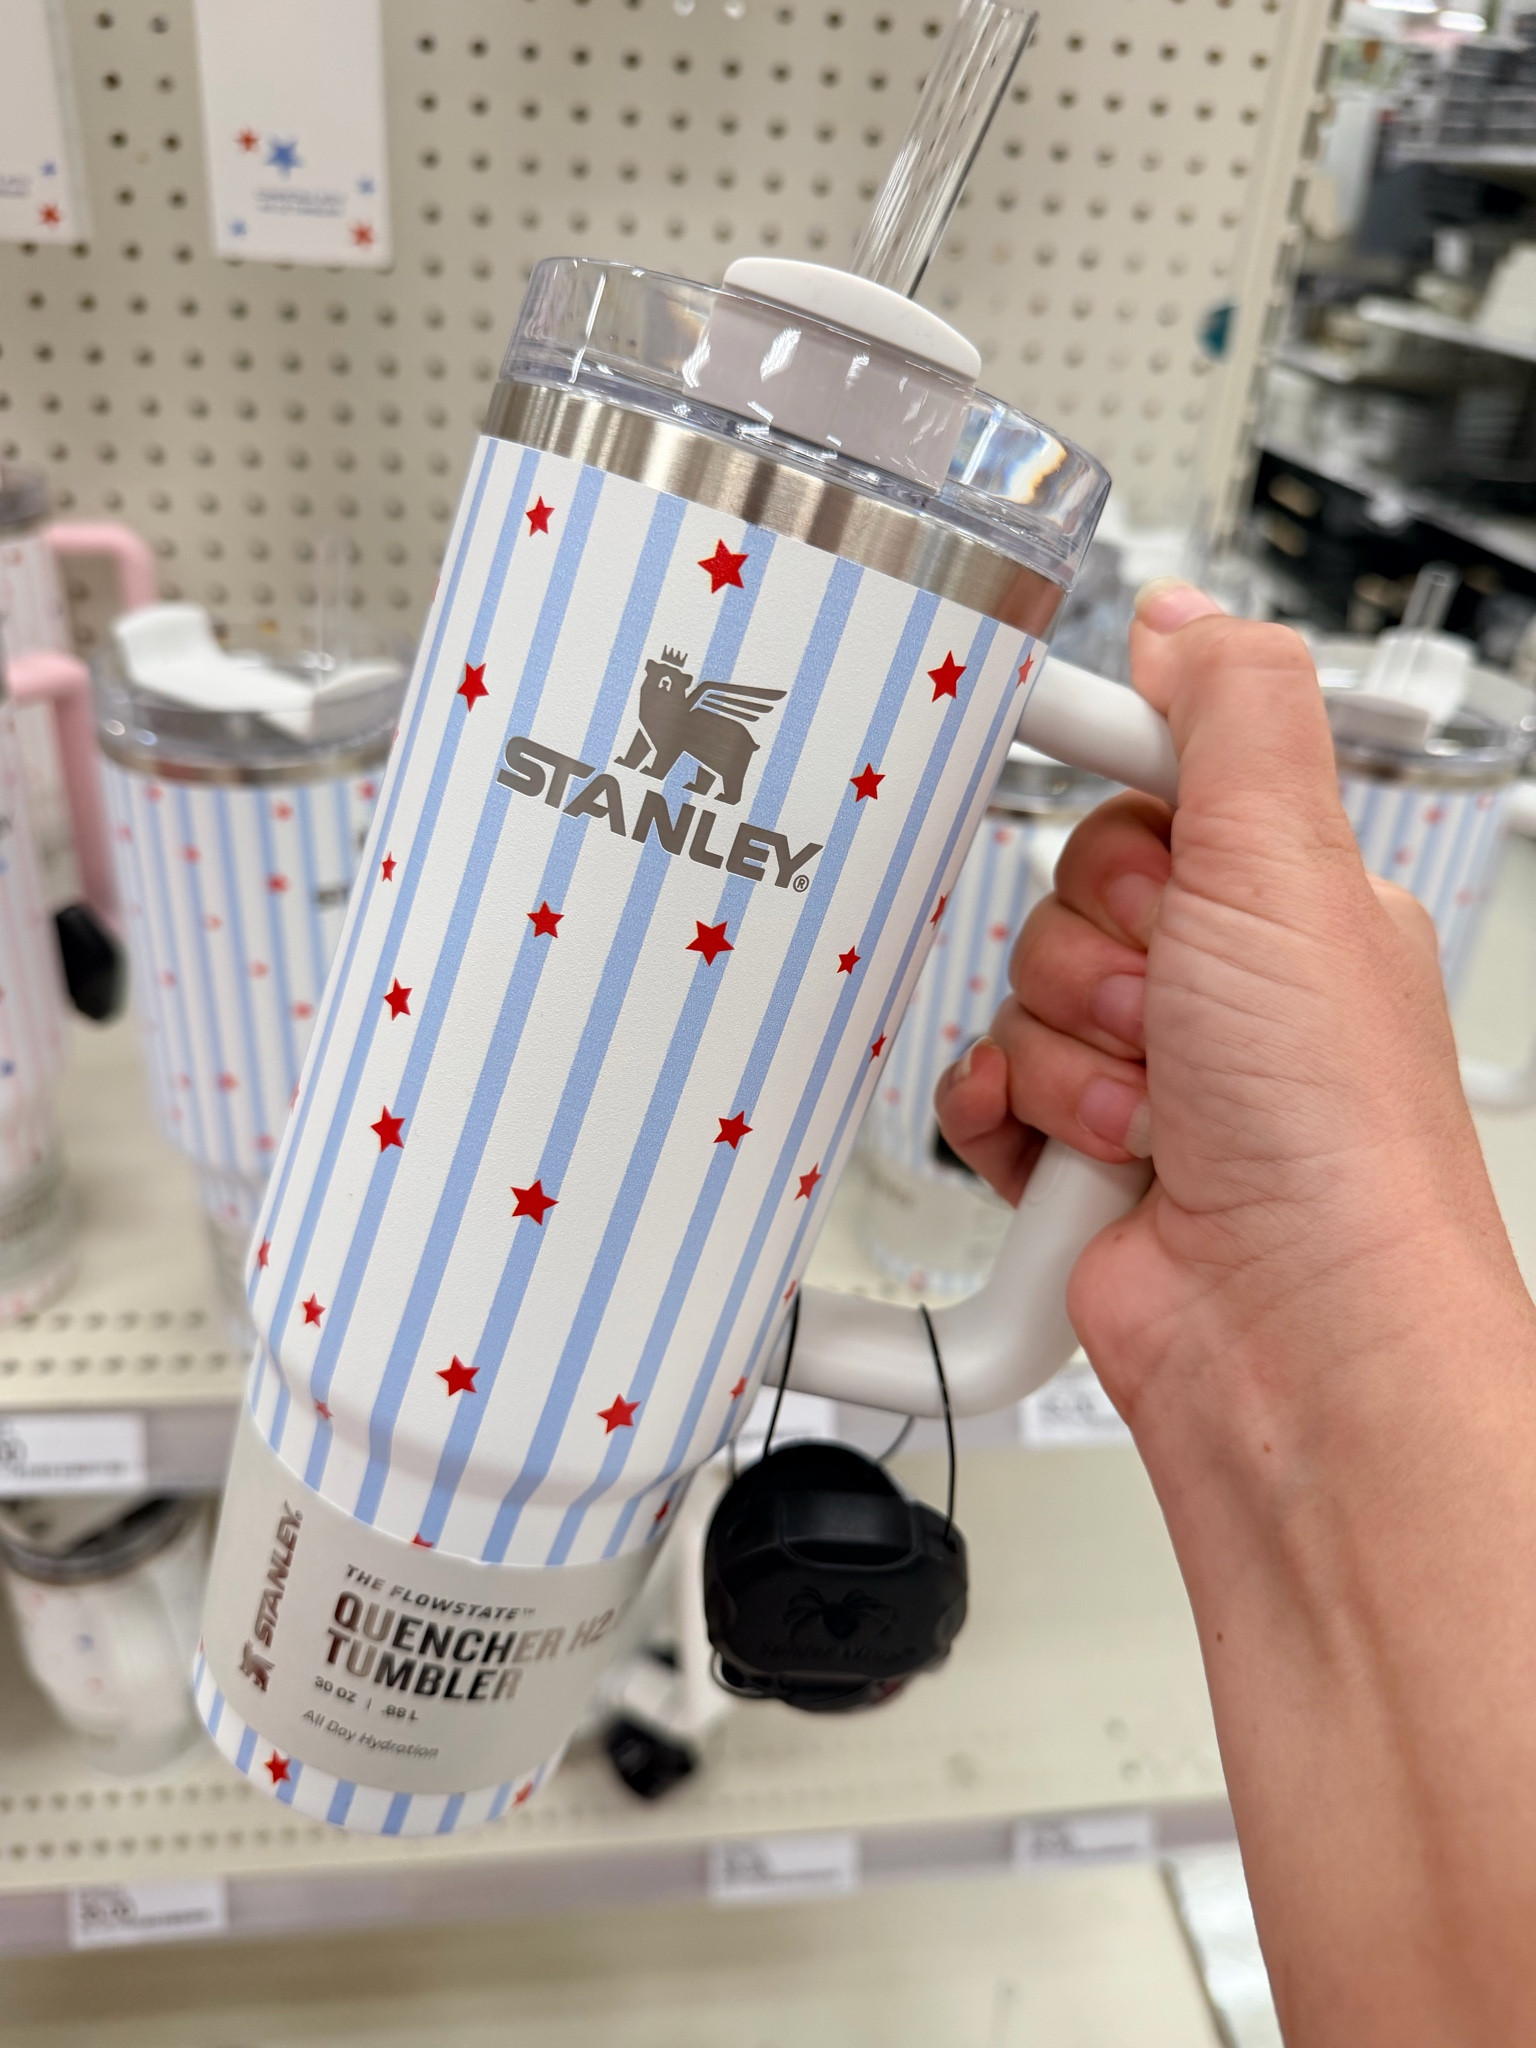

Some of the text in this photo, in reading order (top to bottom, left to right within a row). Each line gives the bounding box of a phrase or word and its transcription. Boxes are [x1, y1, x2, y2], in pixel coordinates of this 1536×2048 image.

[346, 1564, 386, 1591] THE
[334, 1590, 566, 1664] QUENCHER
[327, 1626, 524, 1700] TUMBLER
[314, 1675, 333, 1692] 30
[336, 1687, 358, 1702] OZ
[303, 1709, 439, 1758] All Day Hydration
